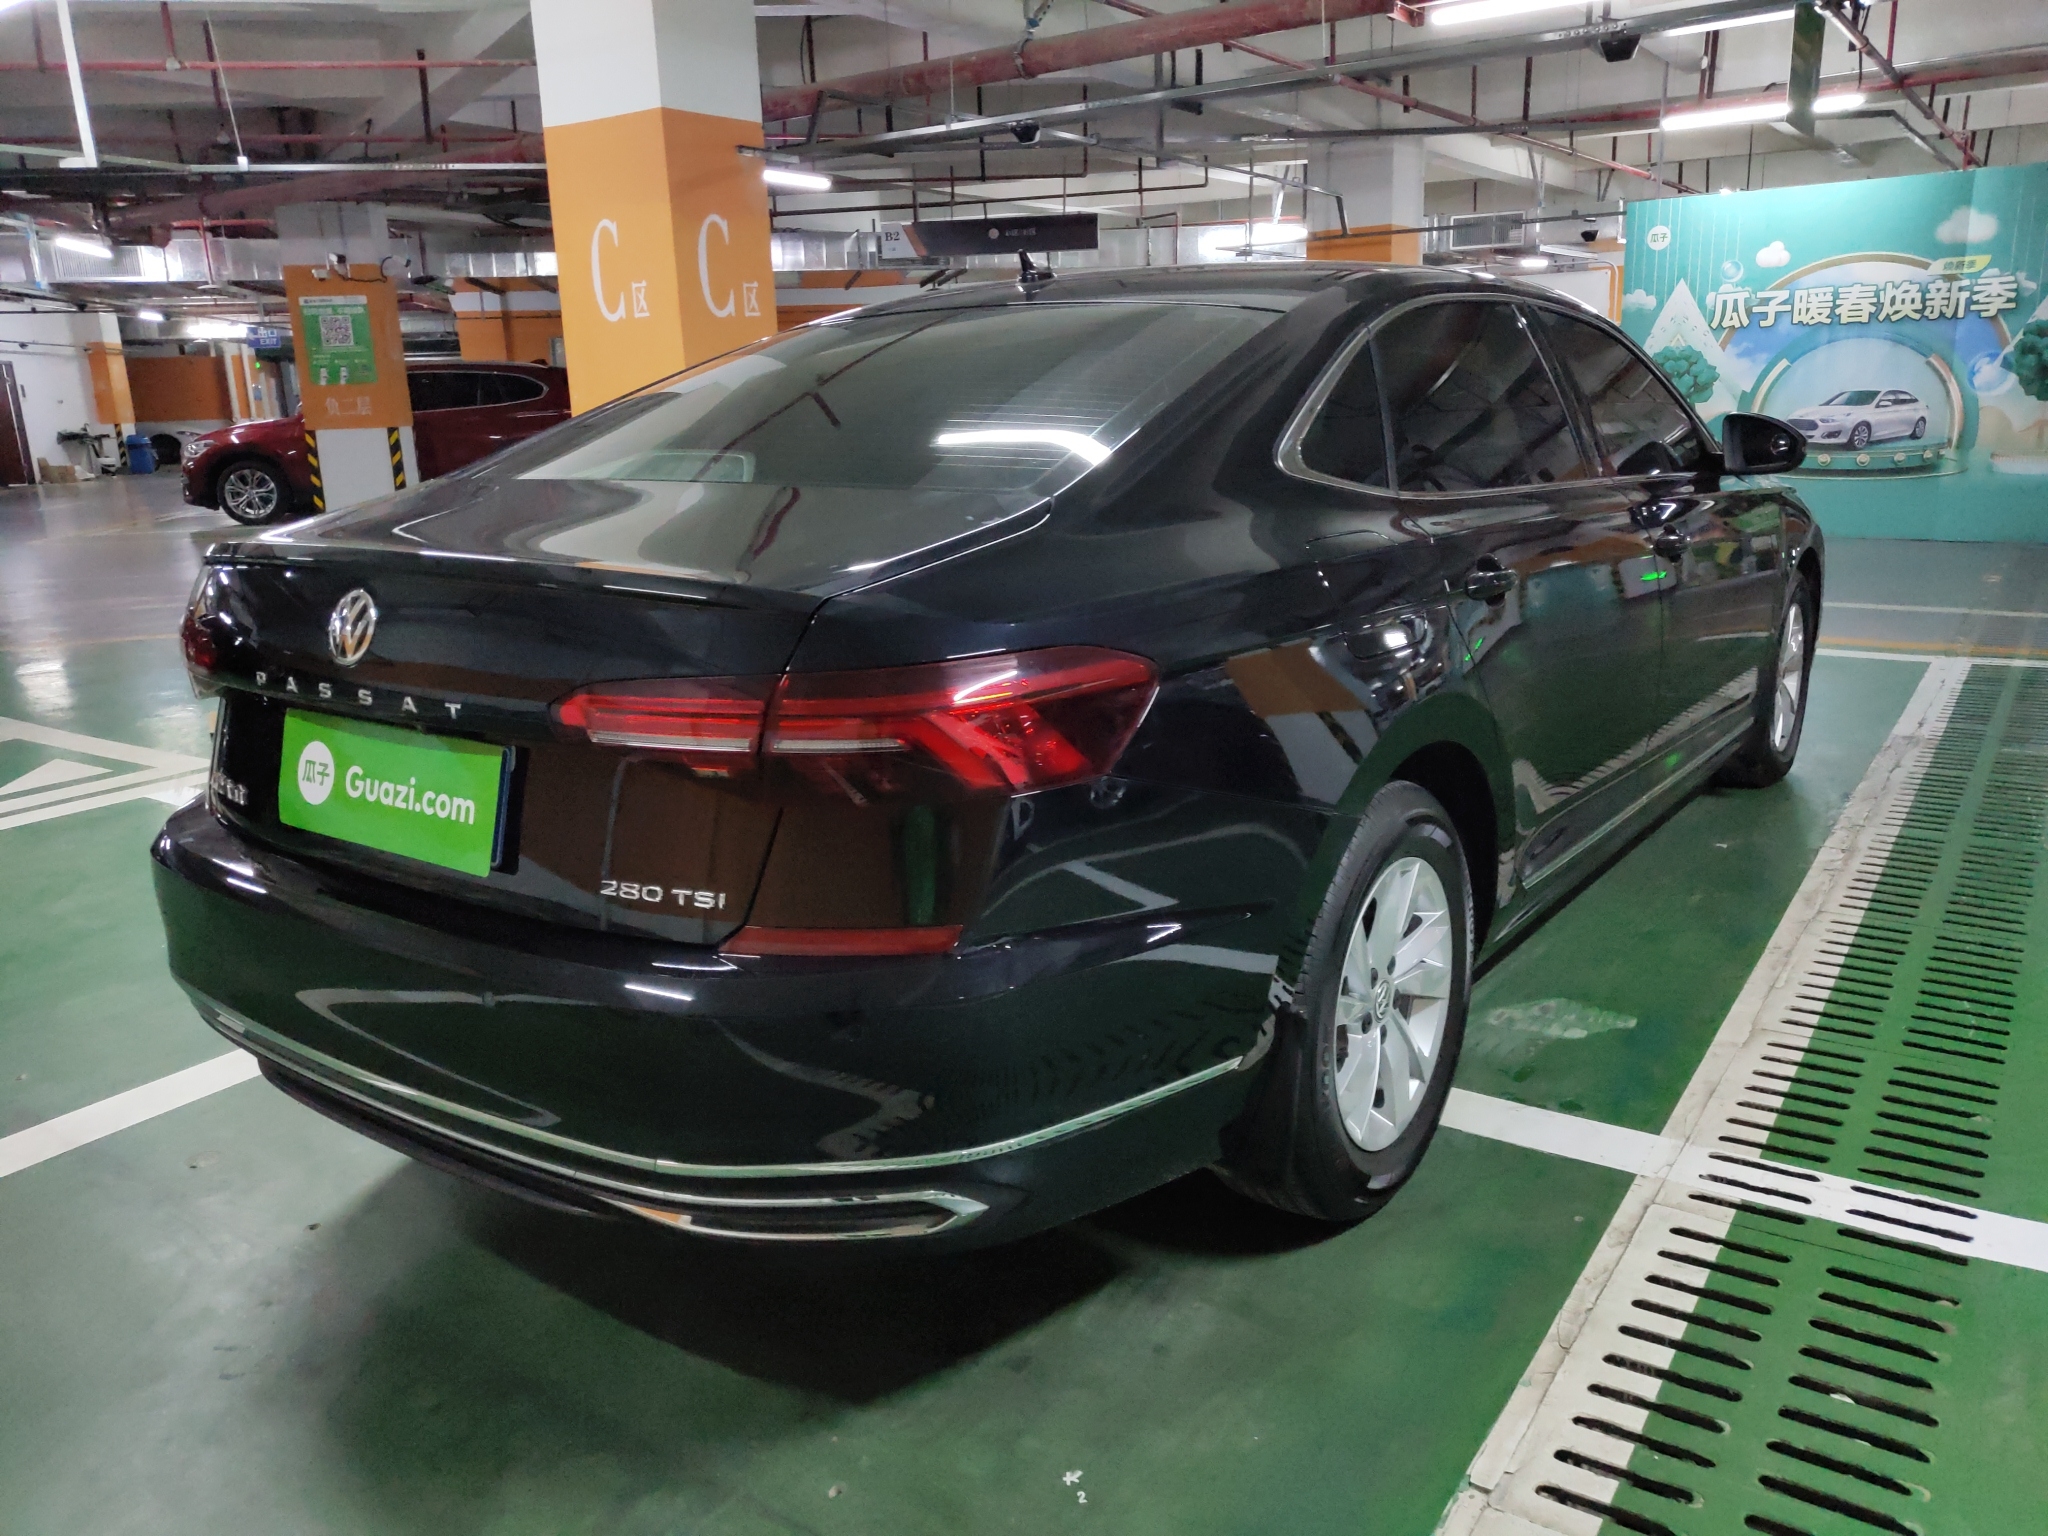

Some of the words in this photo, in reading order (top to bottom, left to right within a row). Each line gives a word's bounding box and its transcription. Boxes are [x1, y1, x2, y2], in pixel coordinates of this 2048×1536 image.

[884, 231, 901, 242] B2
[1650, 232, 1669, 244] 瓜子
[591, 219, 650, 322] C区
[698, 214, 761, 318] C区
[1710, 275, 2018, 330] 瓜子暖春焕新季
[255, 671, 462, 720] PASSAT
[302, 759, 331, 787] 瓜子
[345, 765, 476, 826] Guazi.com
[600, 880, 664, 903] 280
[670, 888, 726, 910] TSI
